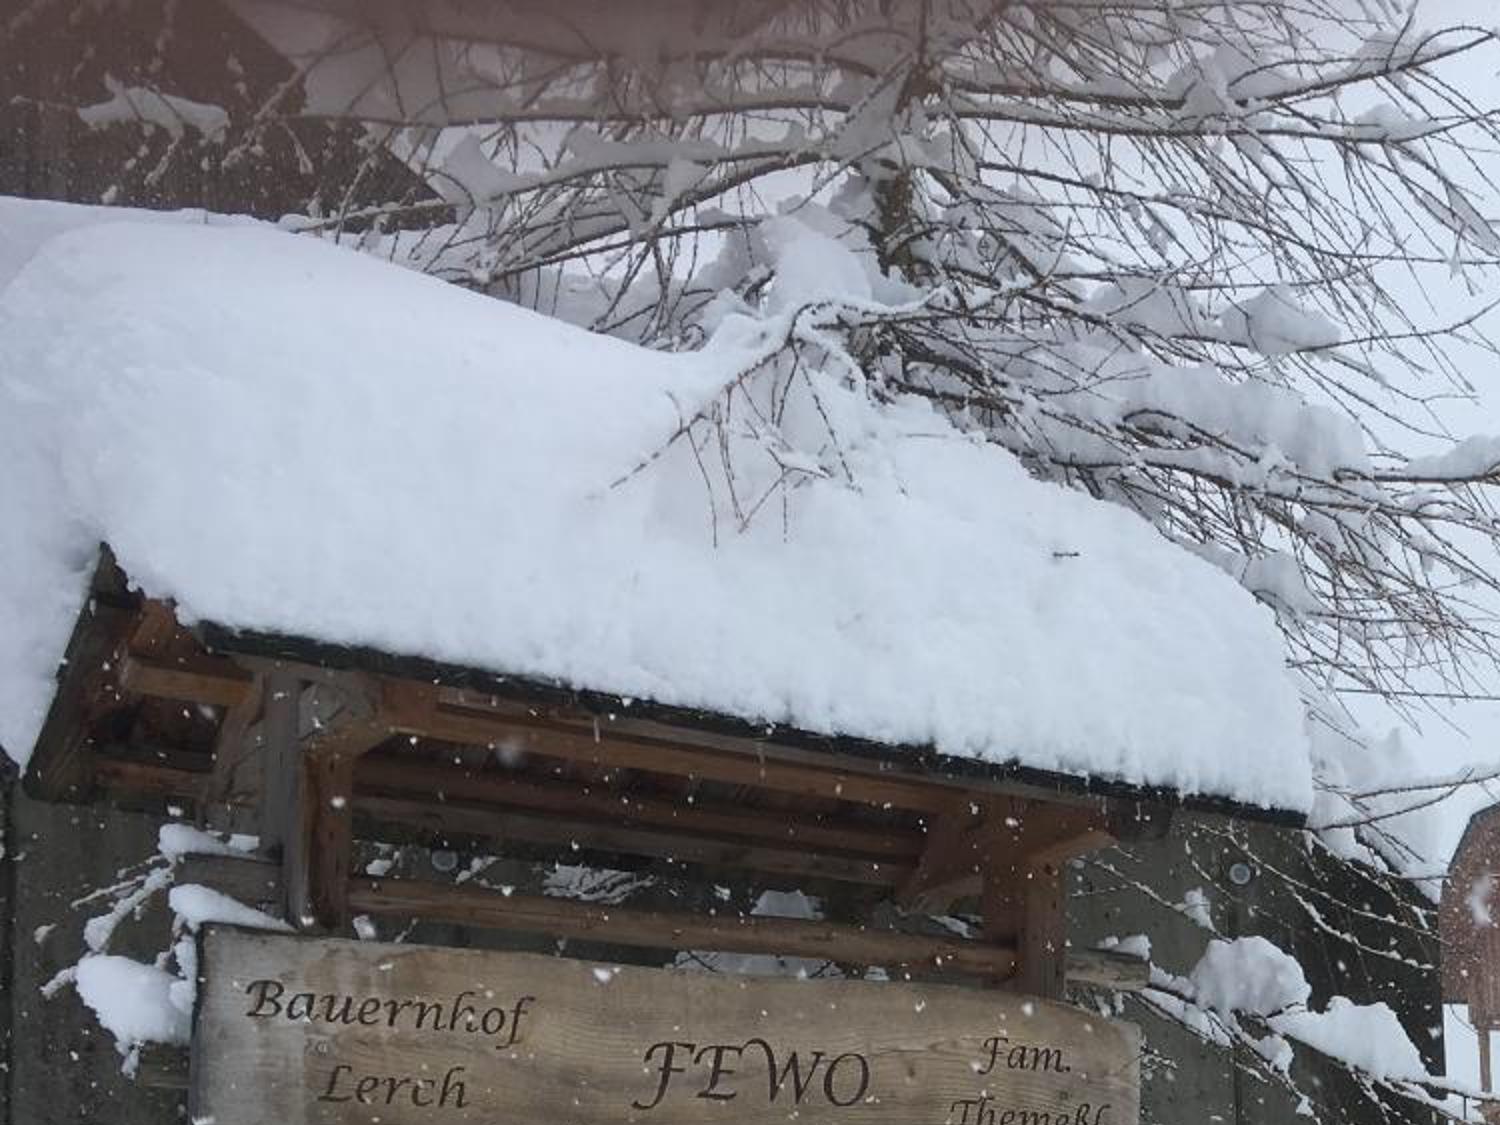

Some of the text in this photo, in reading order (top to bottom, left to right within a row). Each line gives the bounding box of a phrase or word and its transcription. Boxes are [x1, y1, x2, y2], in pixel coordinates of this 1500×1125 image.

[245, 979, 535, 1050] Bauernhof
[632, 1037, 871, 1111] FEWO
[978, 1036, 1072, 1076] Fam.
[317, 1065, 470, 1109] Lerch
